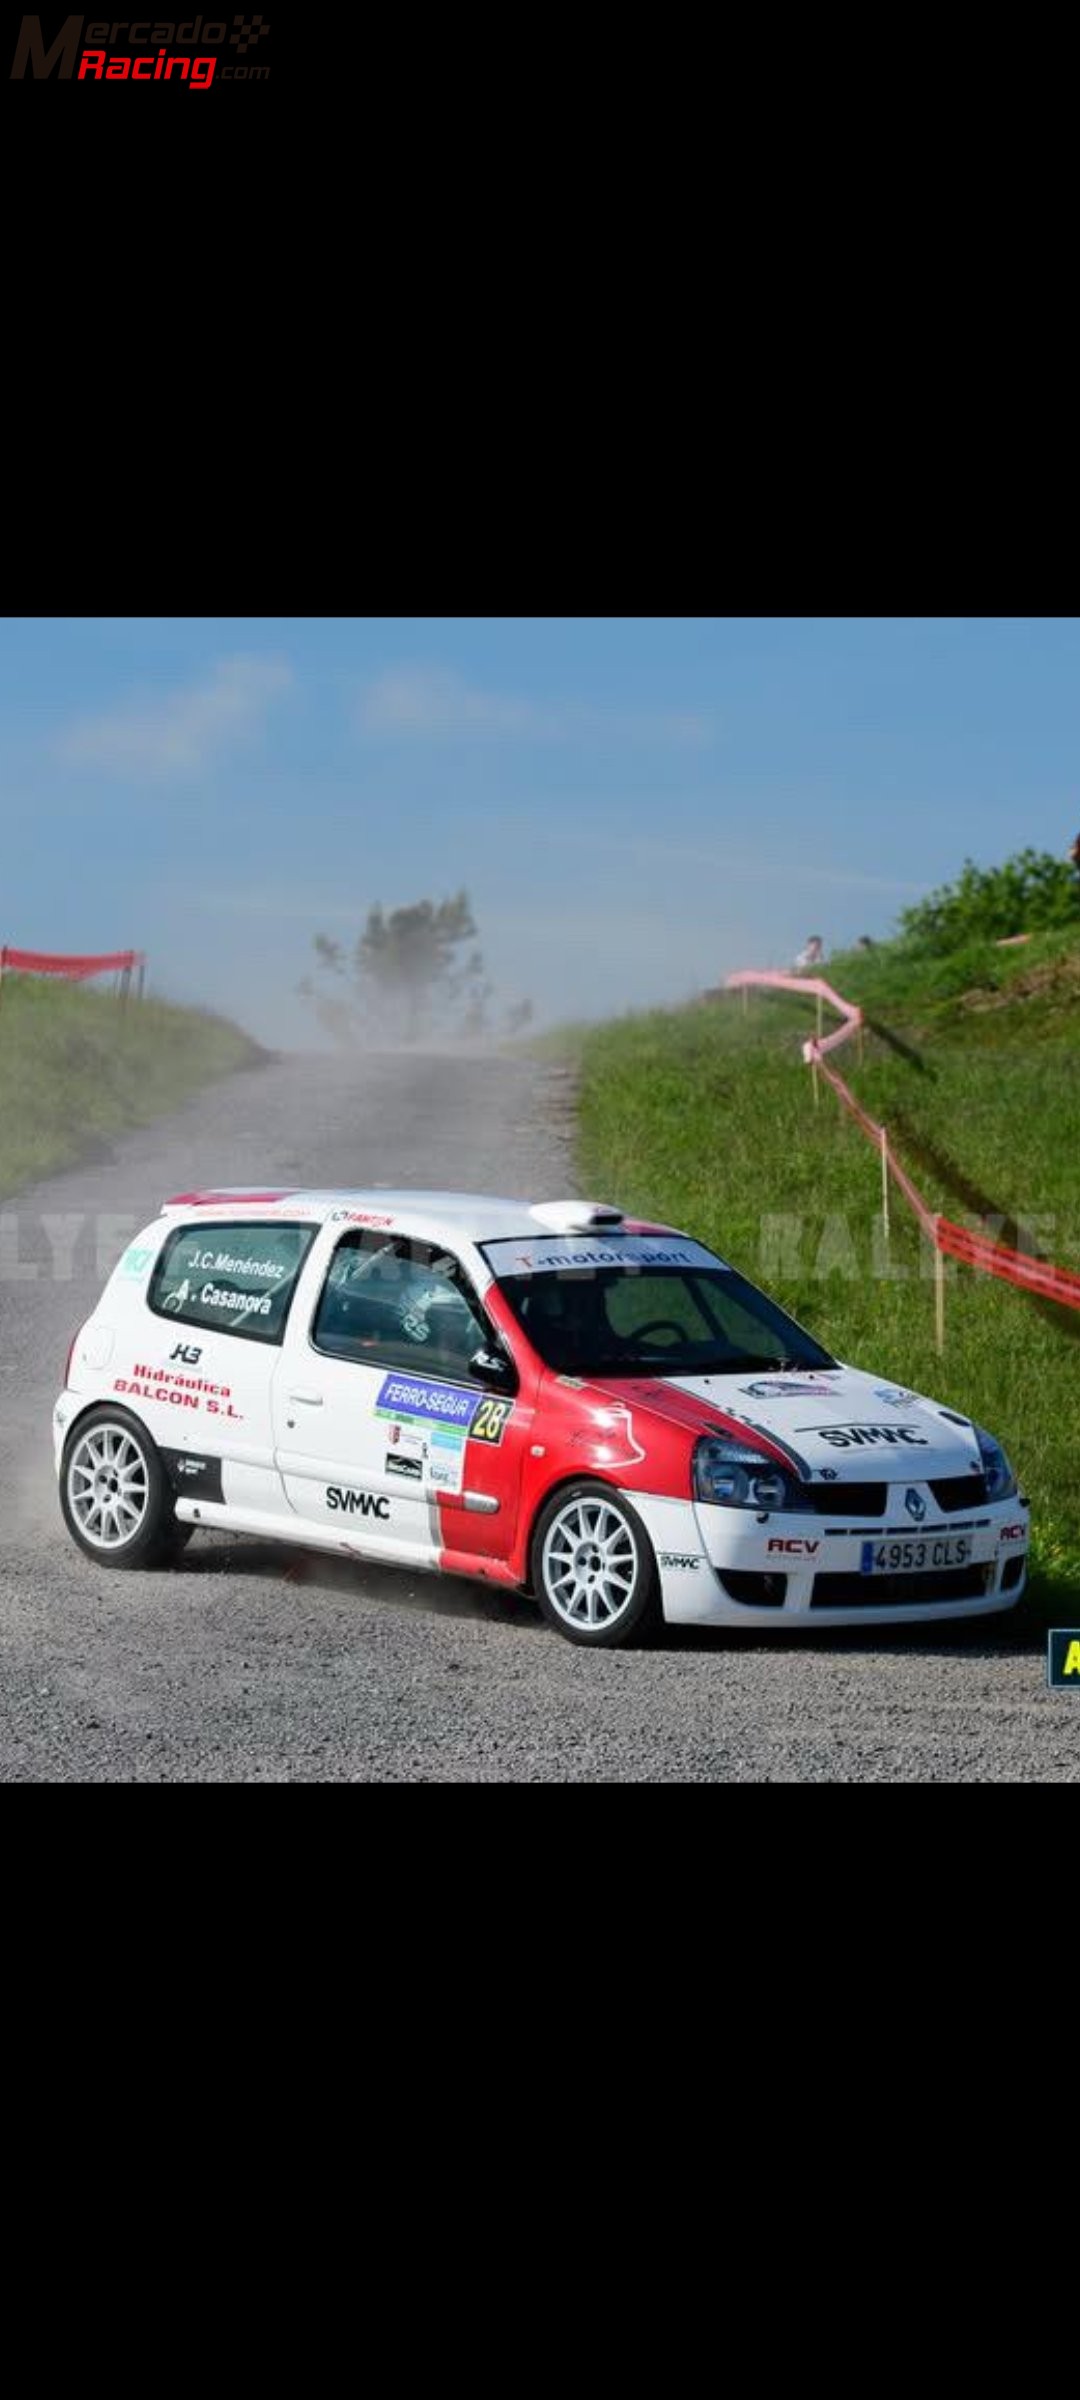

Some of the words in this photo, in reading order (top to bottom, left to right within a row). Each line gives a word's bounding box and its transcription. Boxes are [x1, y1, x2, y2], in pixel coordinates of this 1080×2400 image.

[201, 1282, 272, 1315] Casanova
[132, 1364, 232, 1398] Hidráulica
[113, 1379, 200, 1409] BALCON
[206, 1400, 244, 1420] S.L.
[472, 1400, 506, 1440] 28
[875, 1543, 927, 1569] 4953
